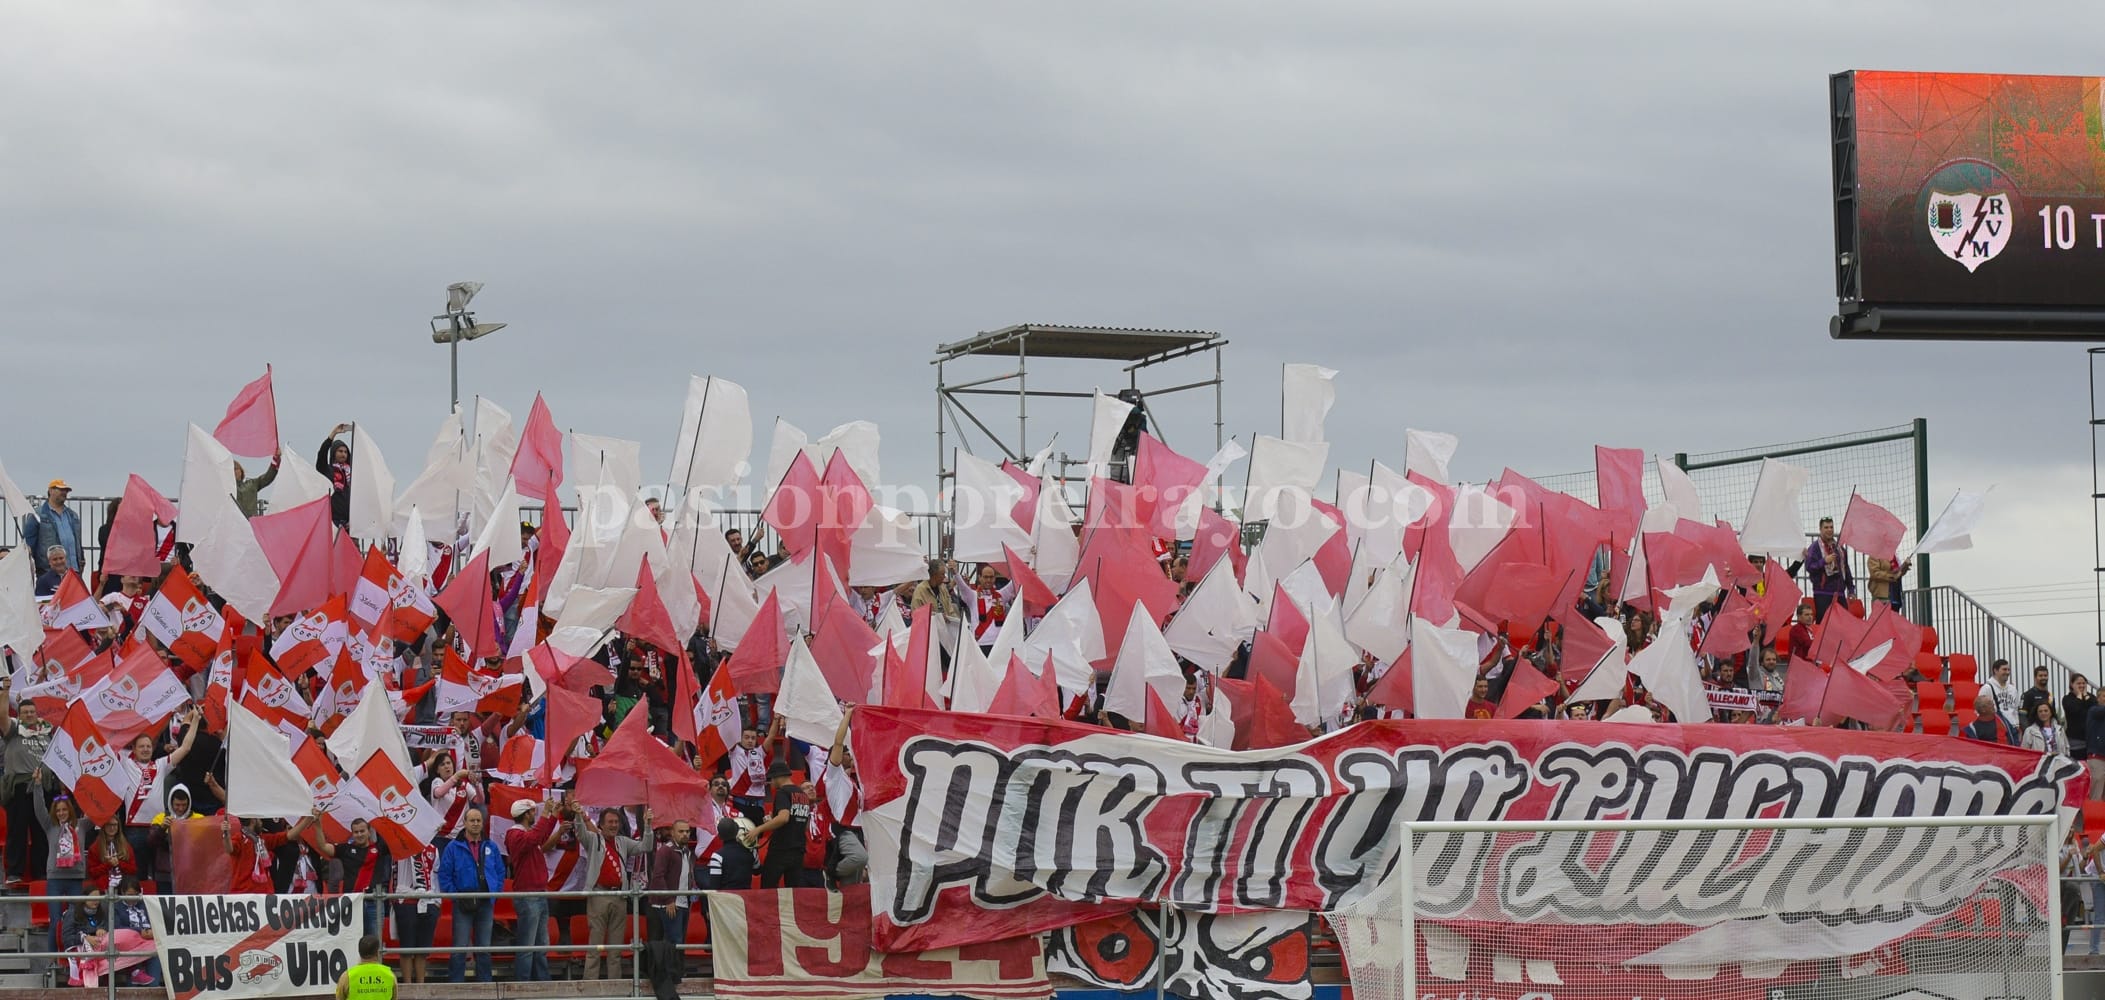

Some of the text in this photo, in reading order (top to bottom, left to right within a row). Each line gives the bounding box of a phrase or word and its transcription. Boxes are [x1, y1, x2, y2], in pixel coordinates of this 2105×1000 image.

[2038, 204, 2076, 250] 10
[894, 738, 1167, 923] POR
[1173, 758, 1326, 911] TI
[1316, 744, 1528, 916] YO
[159, 894, 353, 936] Vallekas Contigo
[167, 942, 348, 993] Bus Uno
[359, 976, 385, 985] C.I.S.
